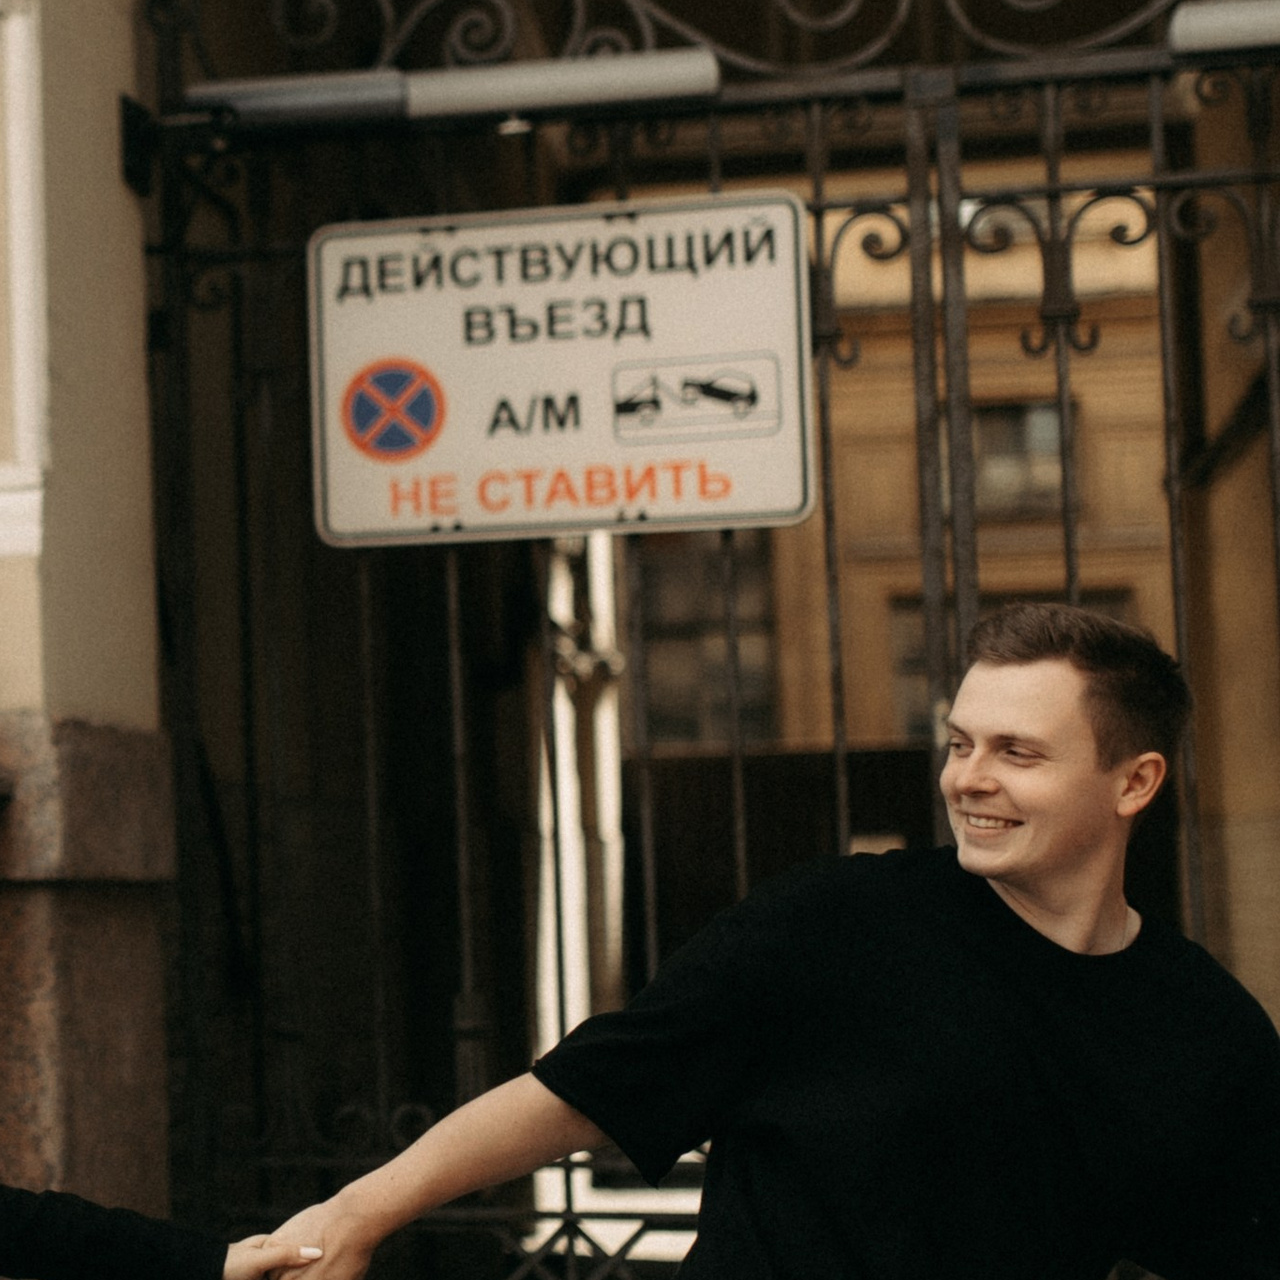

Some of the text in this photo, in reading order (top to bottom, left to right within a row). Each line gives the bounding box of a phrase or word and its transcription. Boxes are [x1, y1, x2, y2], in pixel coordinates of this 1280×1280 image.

[336, 217, 776, 302] ДЕЙСТВУЮЩИЙ
[463, 295, 651, 346] ВЪЕЗД
[488, 394, 581, 438] А/М
[389, 461, 732, 518] НЕ СТАВИТЬ
